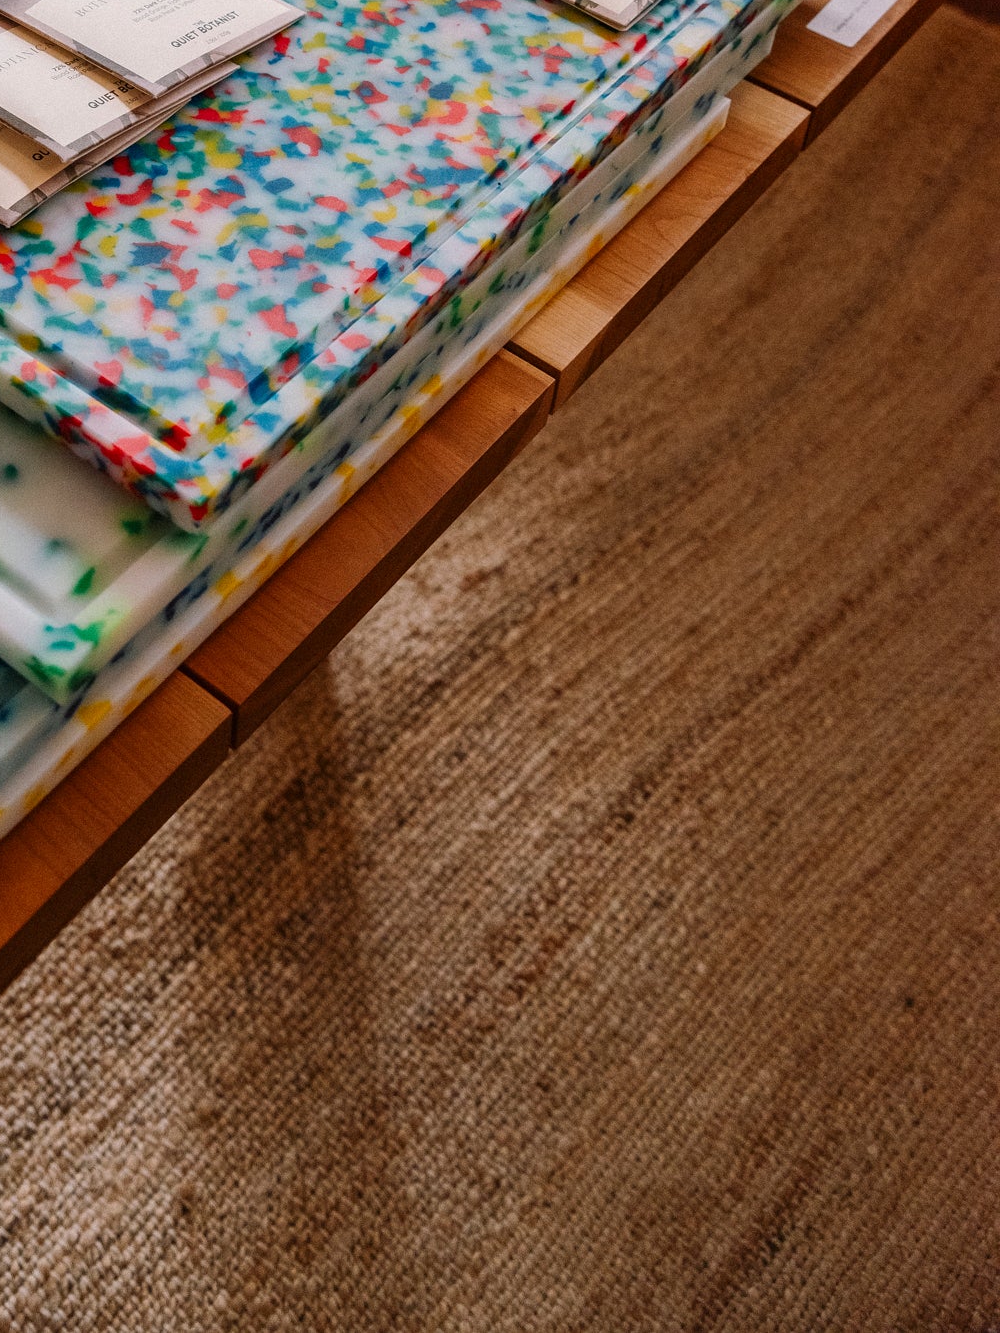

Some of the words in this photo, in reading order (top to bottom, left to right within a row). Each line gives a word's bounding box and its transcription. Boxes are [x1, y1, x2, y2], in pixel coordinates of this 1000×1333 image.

[170, 29, 200, 49] QUIET
[196, 10, 240, 35] BOTANIST
[88, 90, 119, 109] QUIET
